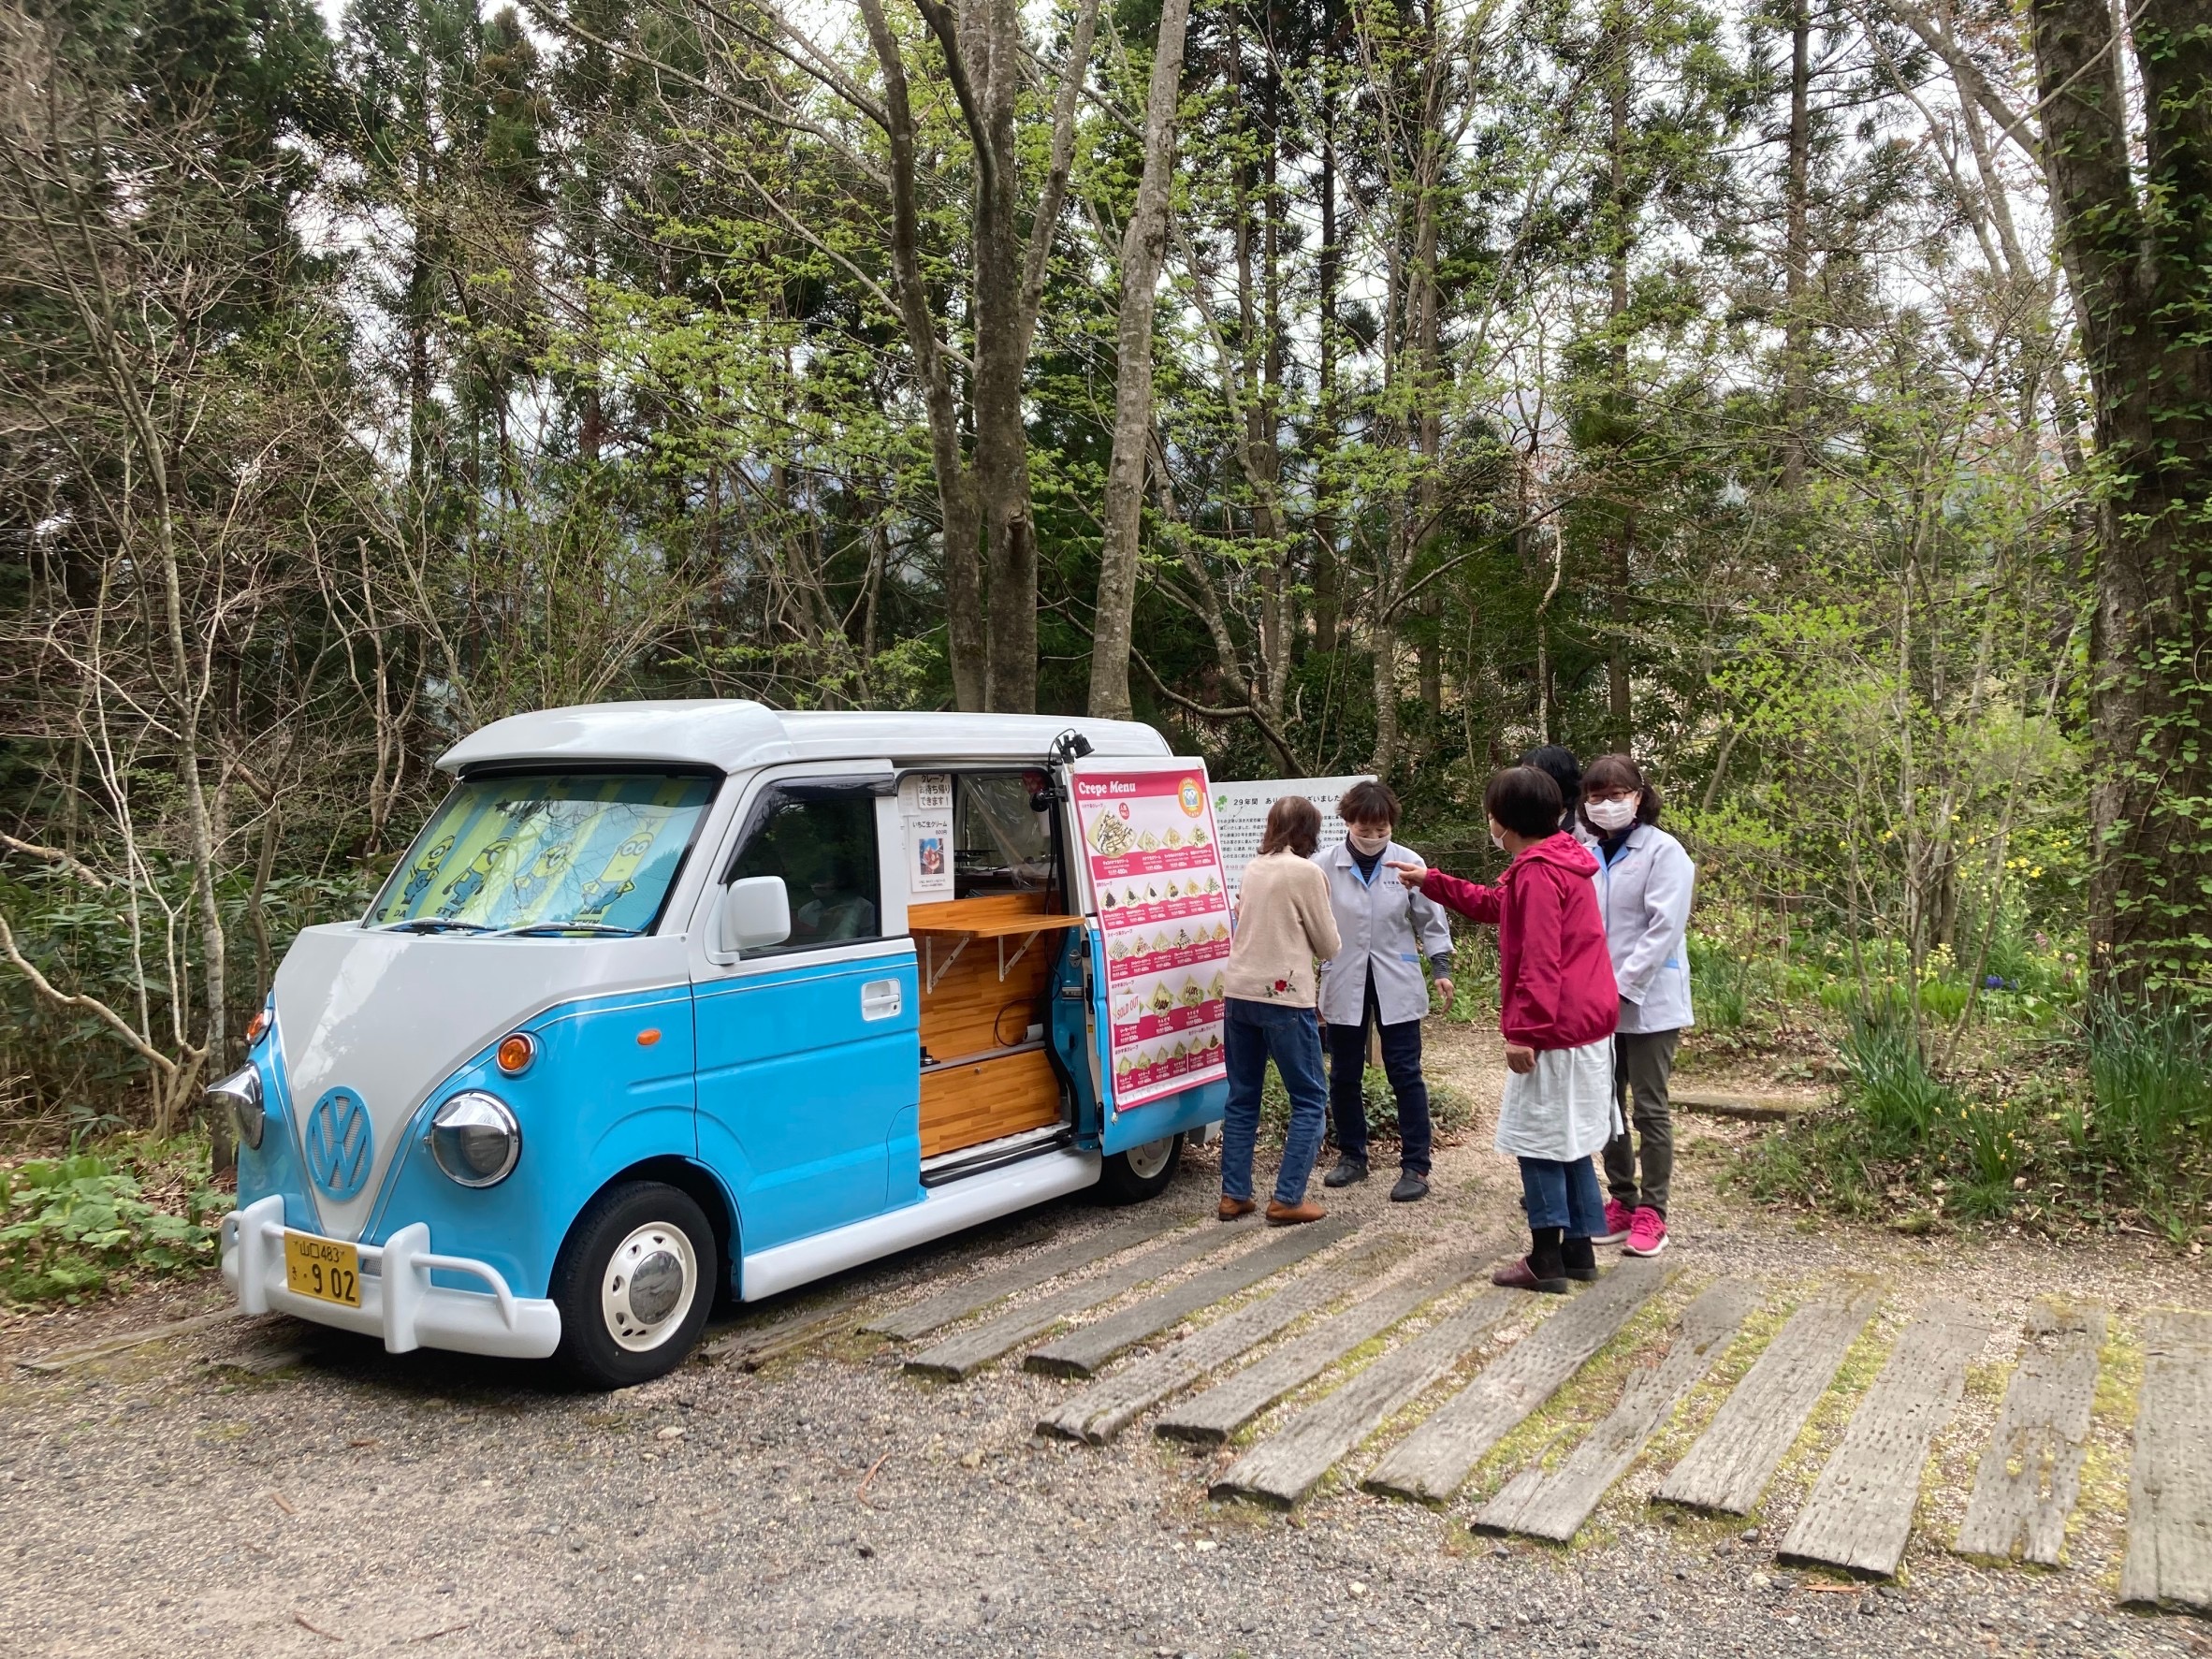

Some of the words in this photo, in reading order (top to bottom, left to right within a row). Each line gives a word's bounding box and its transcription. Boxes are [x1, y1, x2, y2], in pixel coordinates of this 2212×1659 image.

[919, 784, 951, 794] お持ち帰り
[1079, 782, 1107, 796] Crepe
[1110, 781, 1136, 793] Menu
[1117, 1002, 1129, 1020] SOLD
[1129, 996, 1139, 1011] OUT
